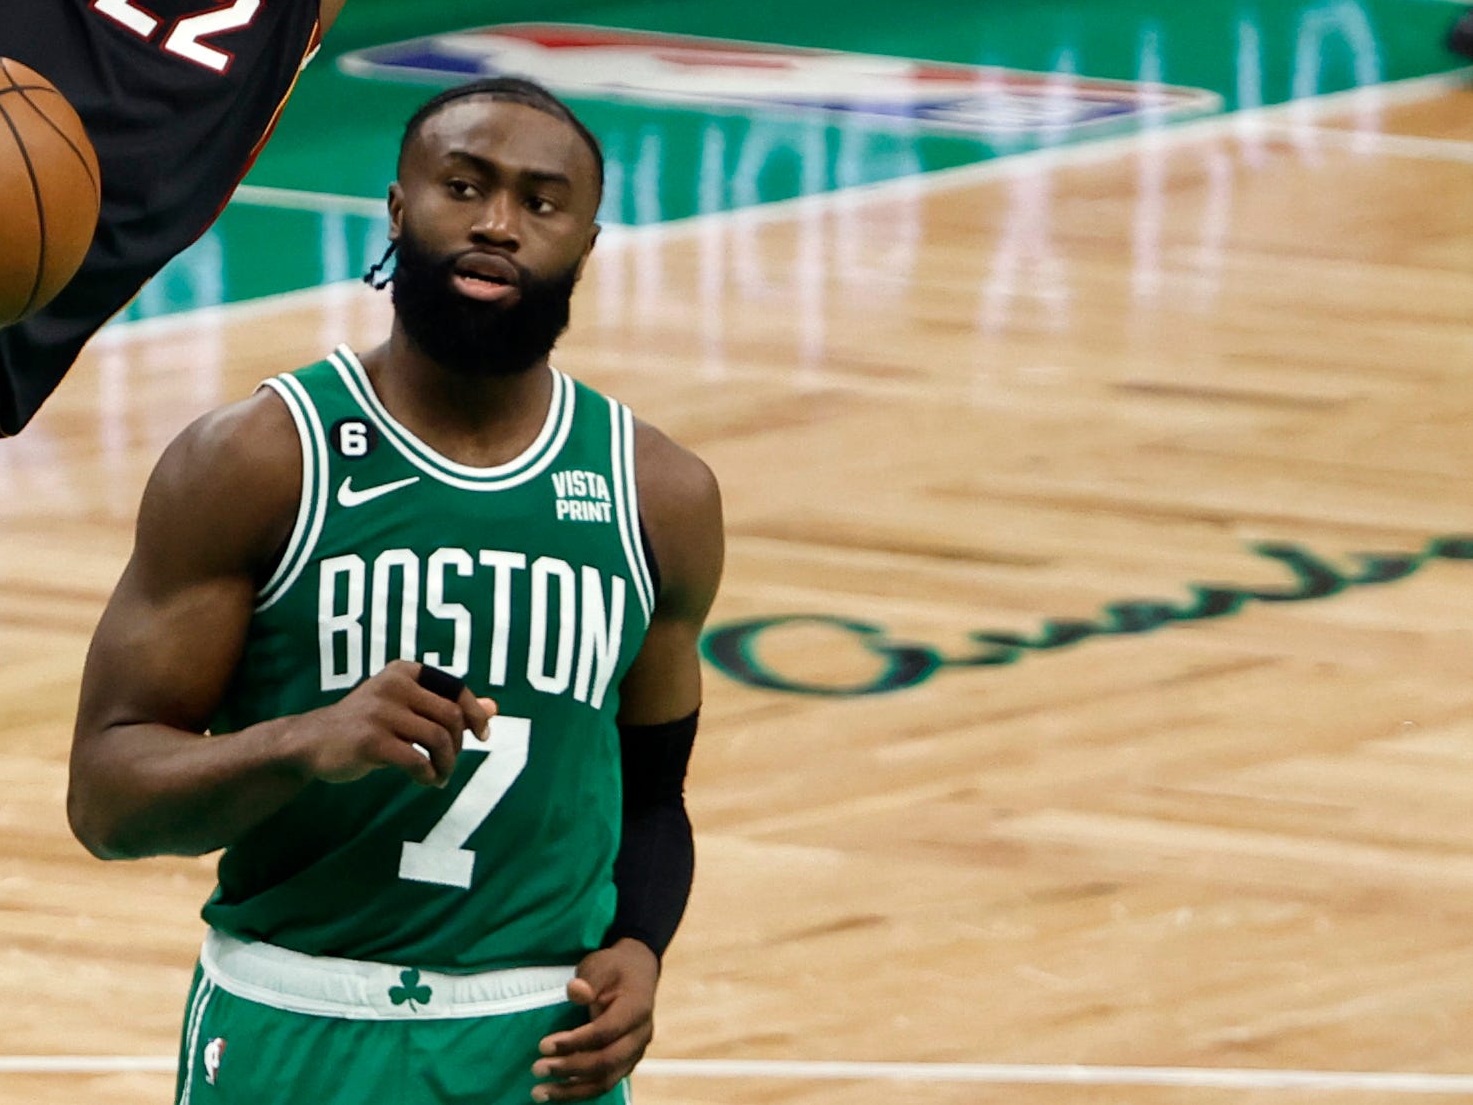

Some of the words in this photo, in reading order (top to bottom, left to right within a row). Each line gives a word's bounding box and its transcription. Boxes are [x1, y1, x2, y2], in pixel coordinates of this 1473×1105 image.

[339, 421, 369, 457] 6
[550, 469, 612, 502] VISTA
[555, 499, 613, 523] PRINT
[317, 547, 627, 711] BOSTON
[398, 714, 532, 890] 7
